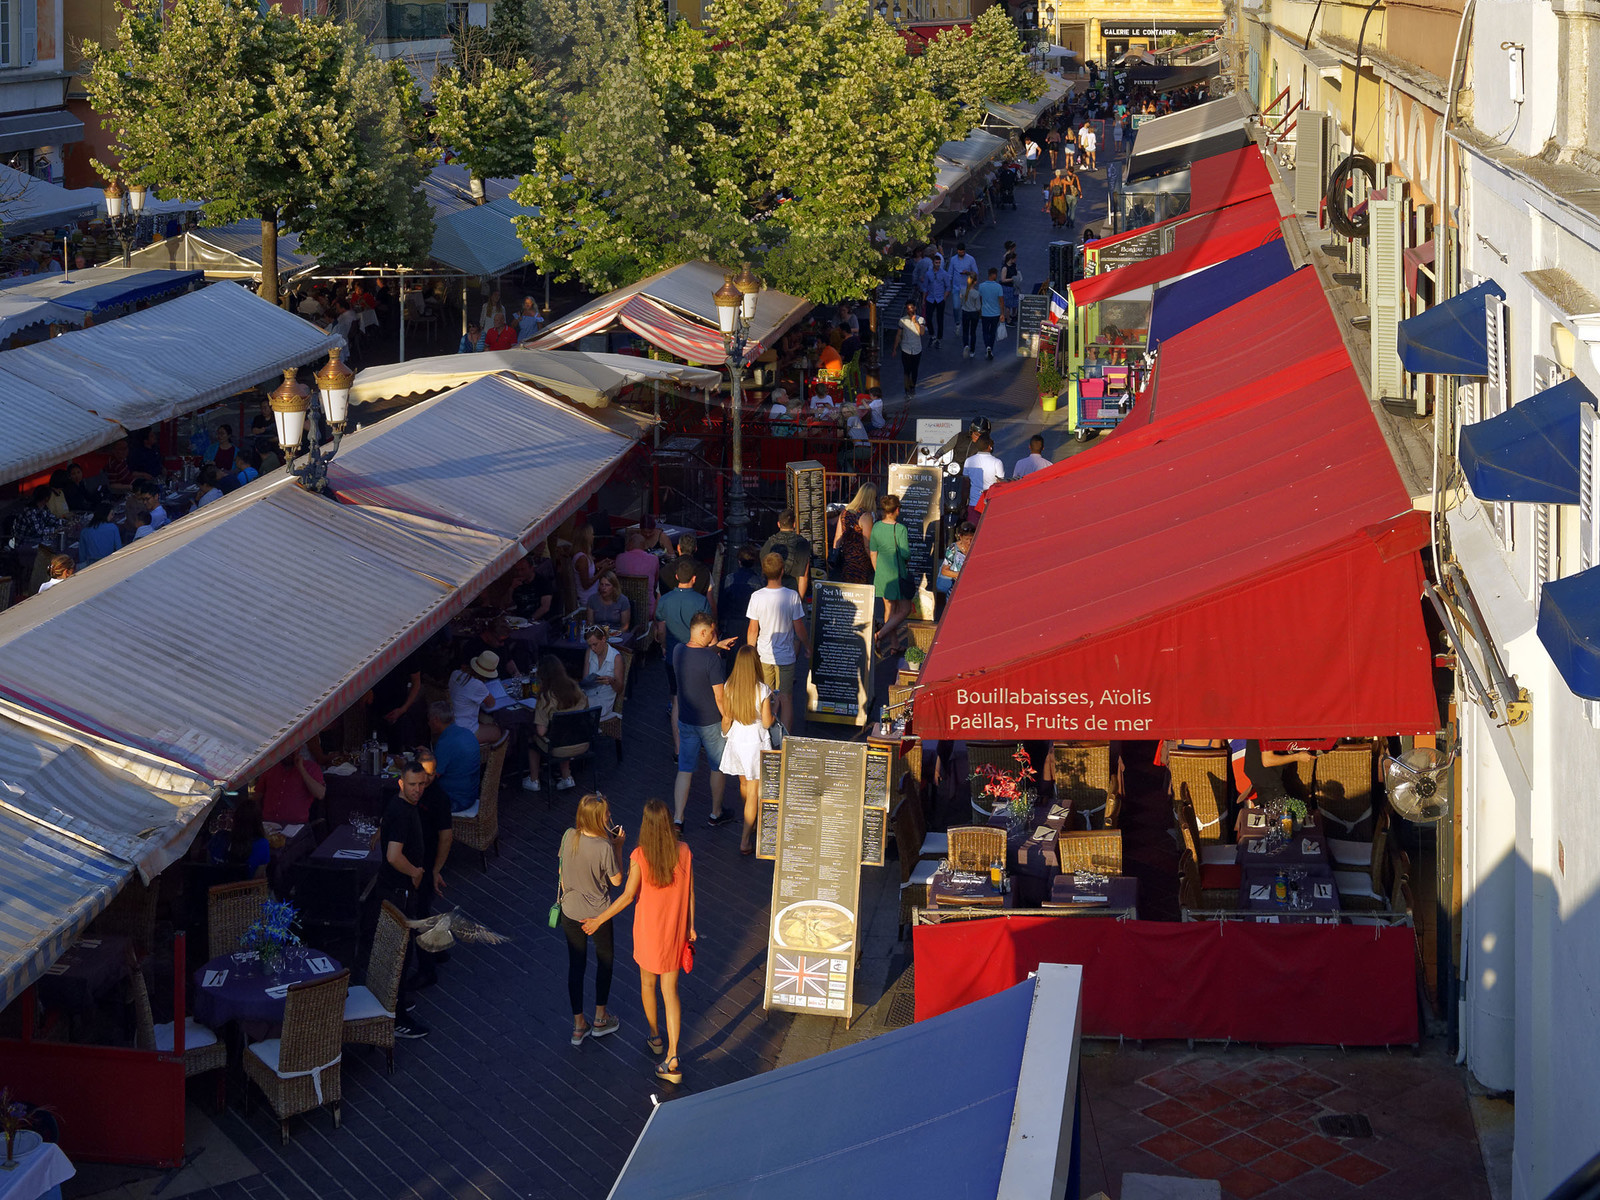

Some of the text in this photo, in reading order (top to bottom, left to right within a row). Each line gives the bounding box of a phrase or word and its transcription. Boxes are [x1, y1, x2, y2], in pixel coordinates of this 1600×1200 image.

[1104, 28, 1130, 36] GALERIE
[1132, 28, 1140, 36] LE
[823, 588, 853, 597] Set Menu
[957, 688, 1152, 708] Bouillabaisses, Aïolis
[950, 712, 1153, 731] Paëllas, Fruits de mer
